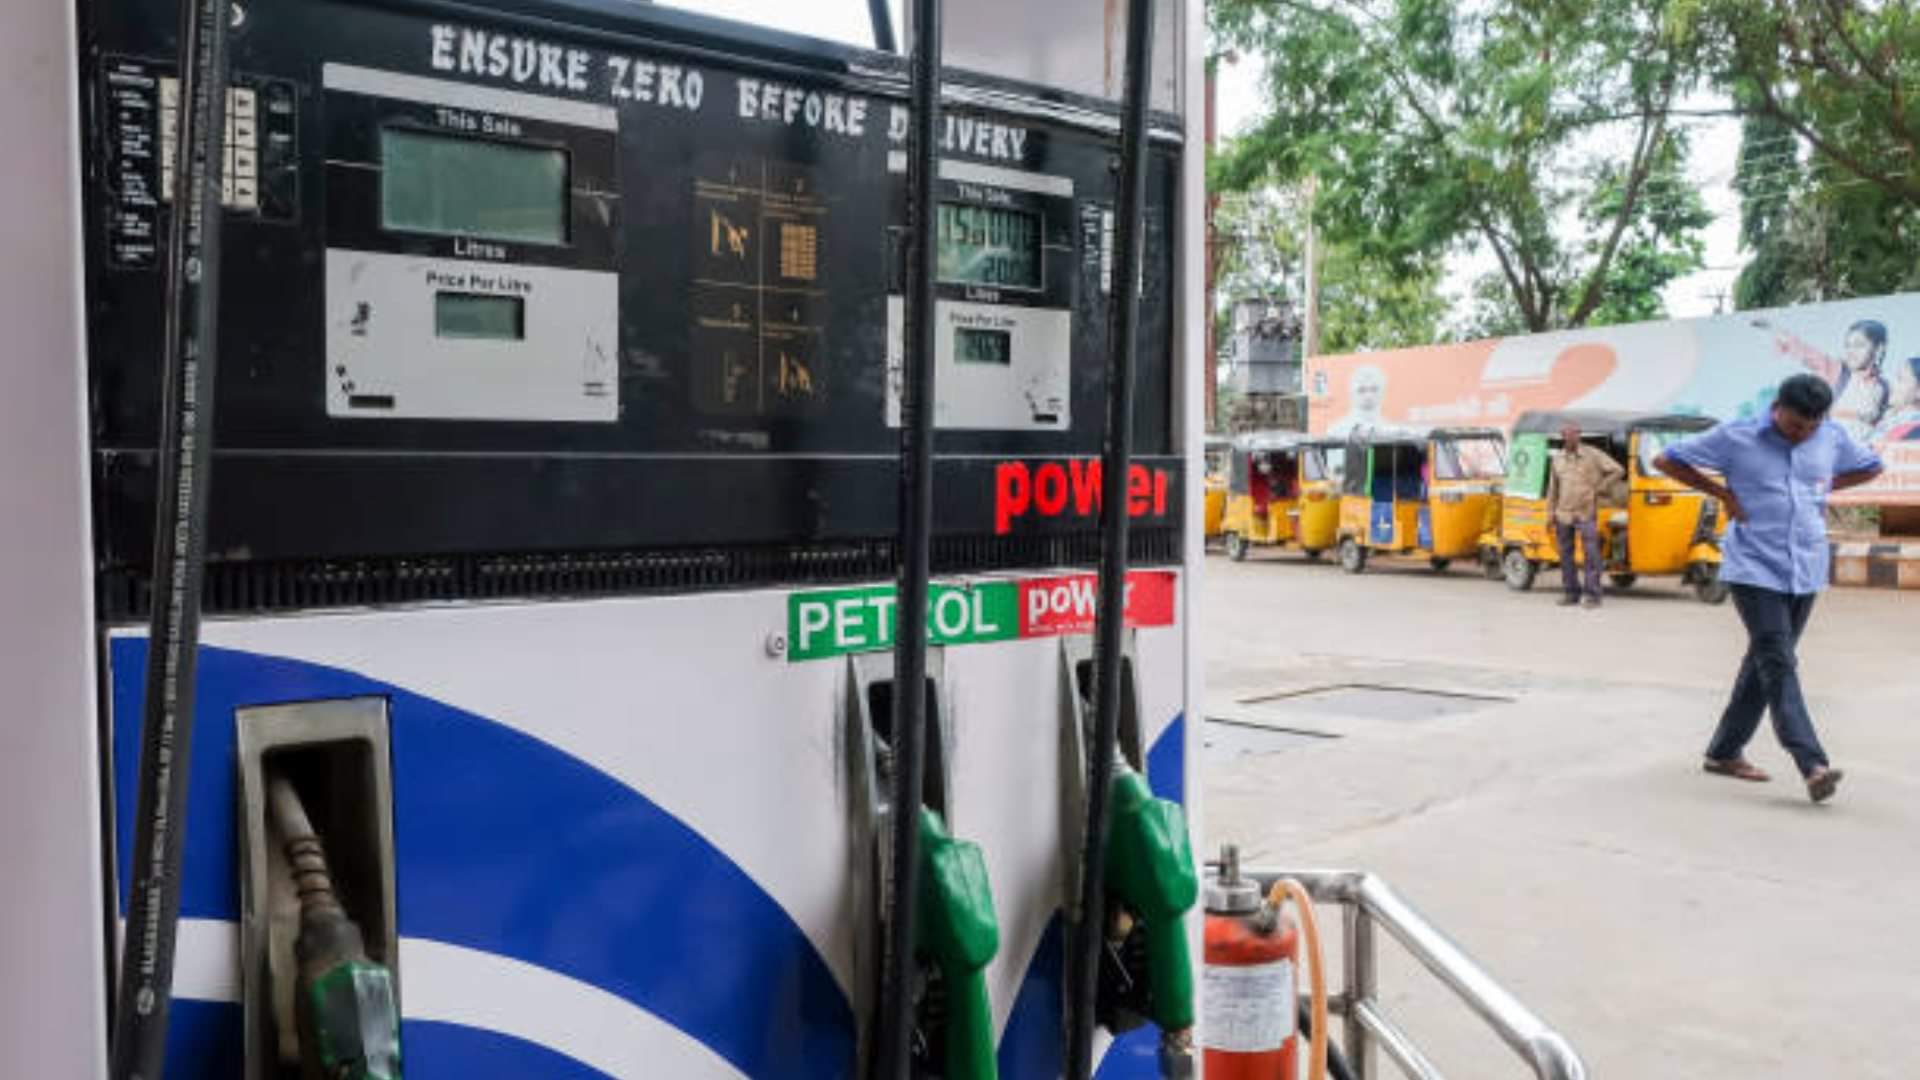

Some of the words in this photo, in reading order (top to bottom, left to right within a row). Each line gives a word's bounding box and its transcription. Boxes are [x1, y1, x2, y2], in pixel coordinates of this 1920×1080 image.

[431, 23, 590, 91] ENSURE
[607, 55, 704, 111] ZERO
[736, 78, 867, 136] BEFORE
[887, 106, 1026, 160] DIVERY
[436, 109, 477, 130] This
[482, 115, 521, 137] Sale
[426, 270, 465, 287] Price
[470, 274, 495, 289] Per
[800, 590, 998, 650] PETOL
